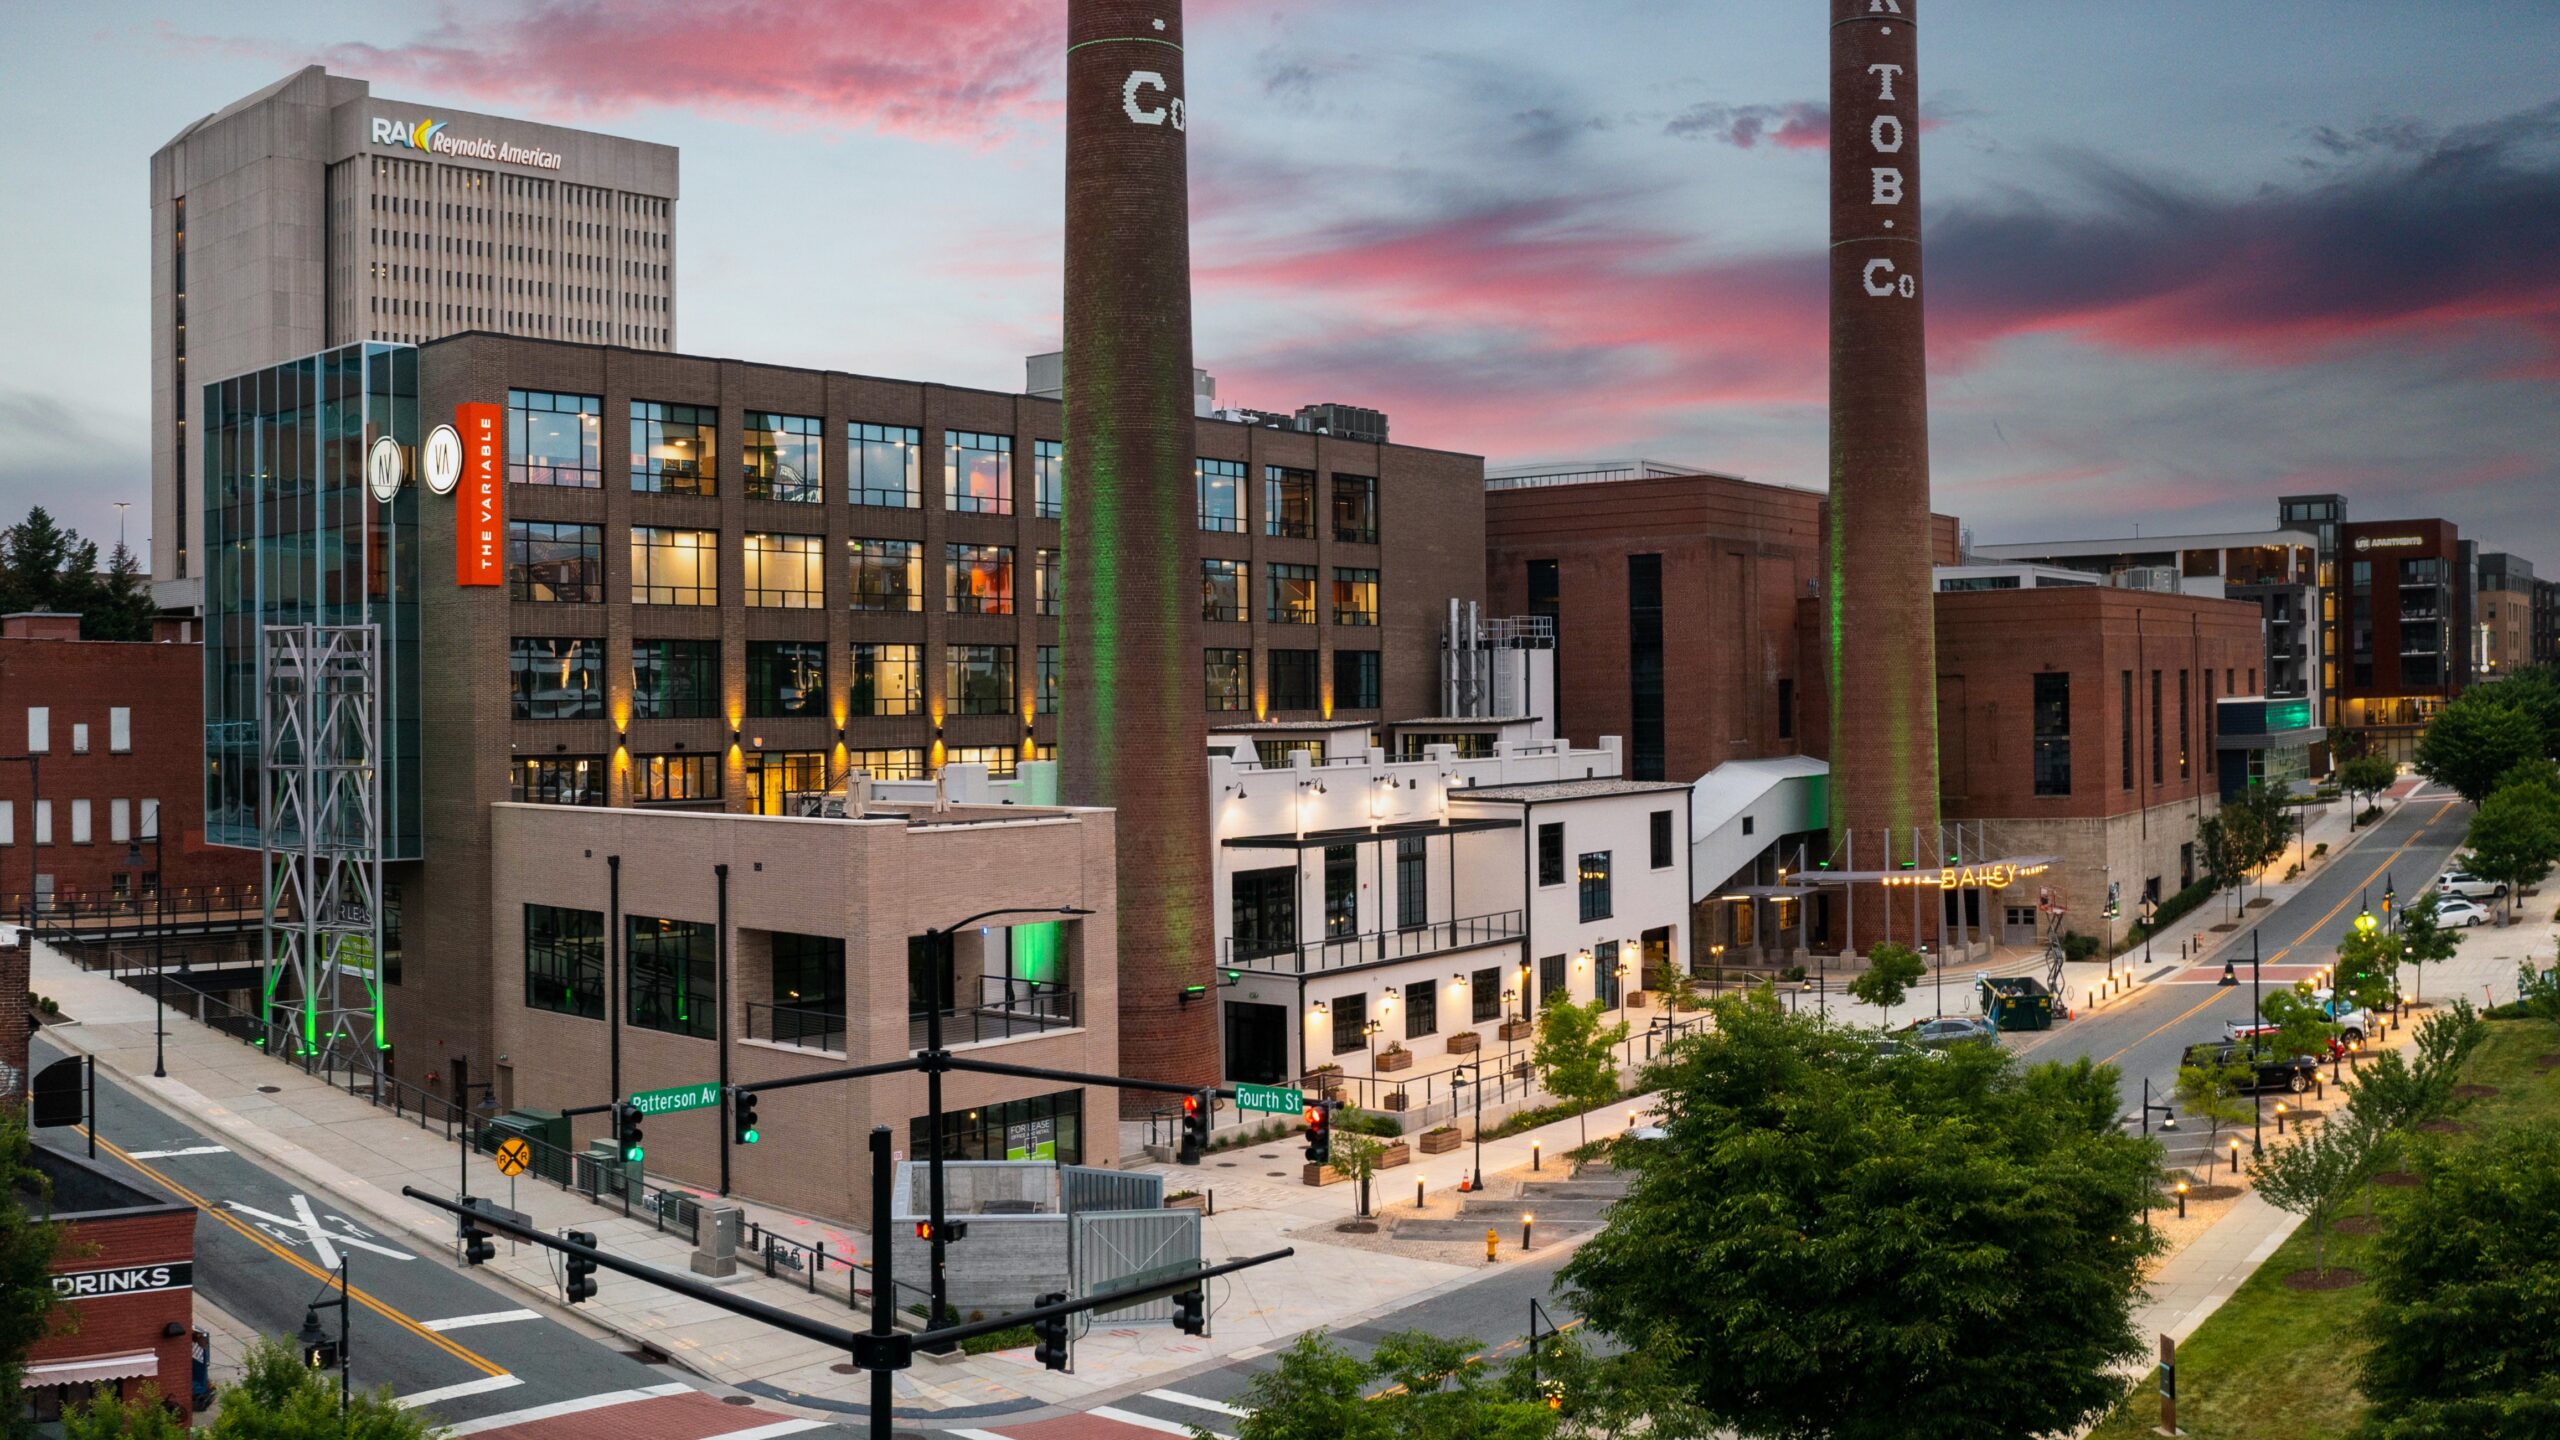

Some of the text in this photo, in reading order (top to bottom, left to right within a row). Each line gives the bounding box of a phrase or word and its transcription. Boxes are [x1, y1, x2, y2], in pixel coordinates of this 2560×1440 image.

[372, 116, 562, 171] RAI Reynolds American
[1862, 258, 1916, 299] Co
[480, 418, 492, 570] THE VARIABLE
[1940, 863, 2017, 889] BAILEY
[632, 1087, 717, 1113] Patterson Av
[1237, 1087, 1300, 1112] Fourth St
[1010, 1119, 1050, 1135] FOR LEASE
[499, 1151, 528, 1164] R R
[52, 1267, 170, 1295] DRINKS
